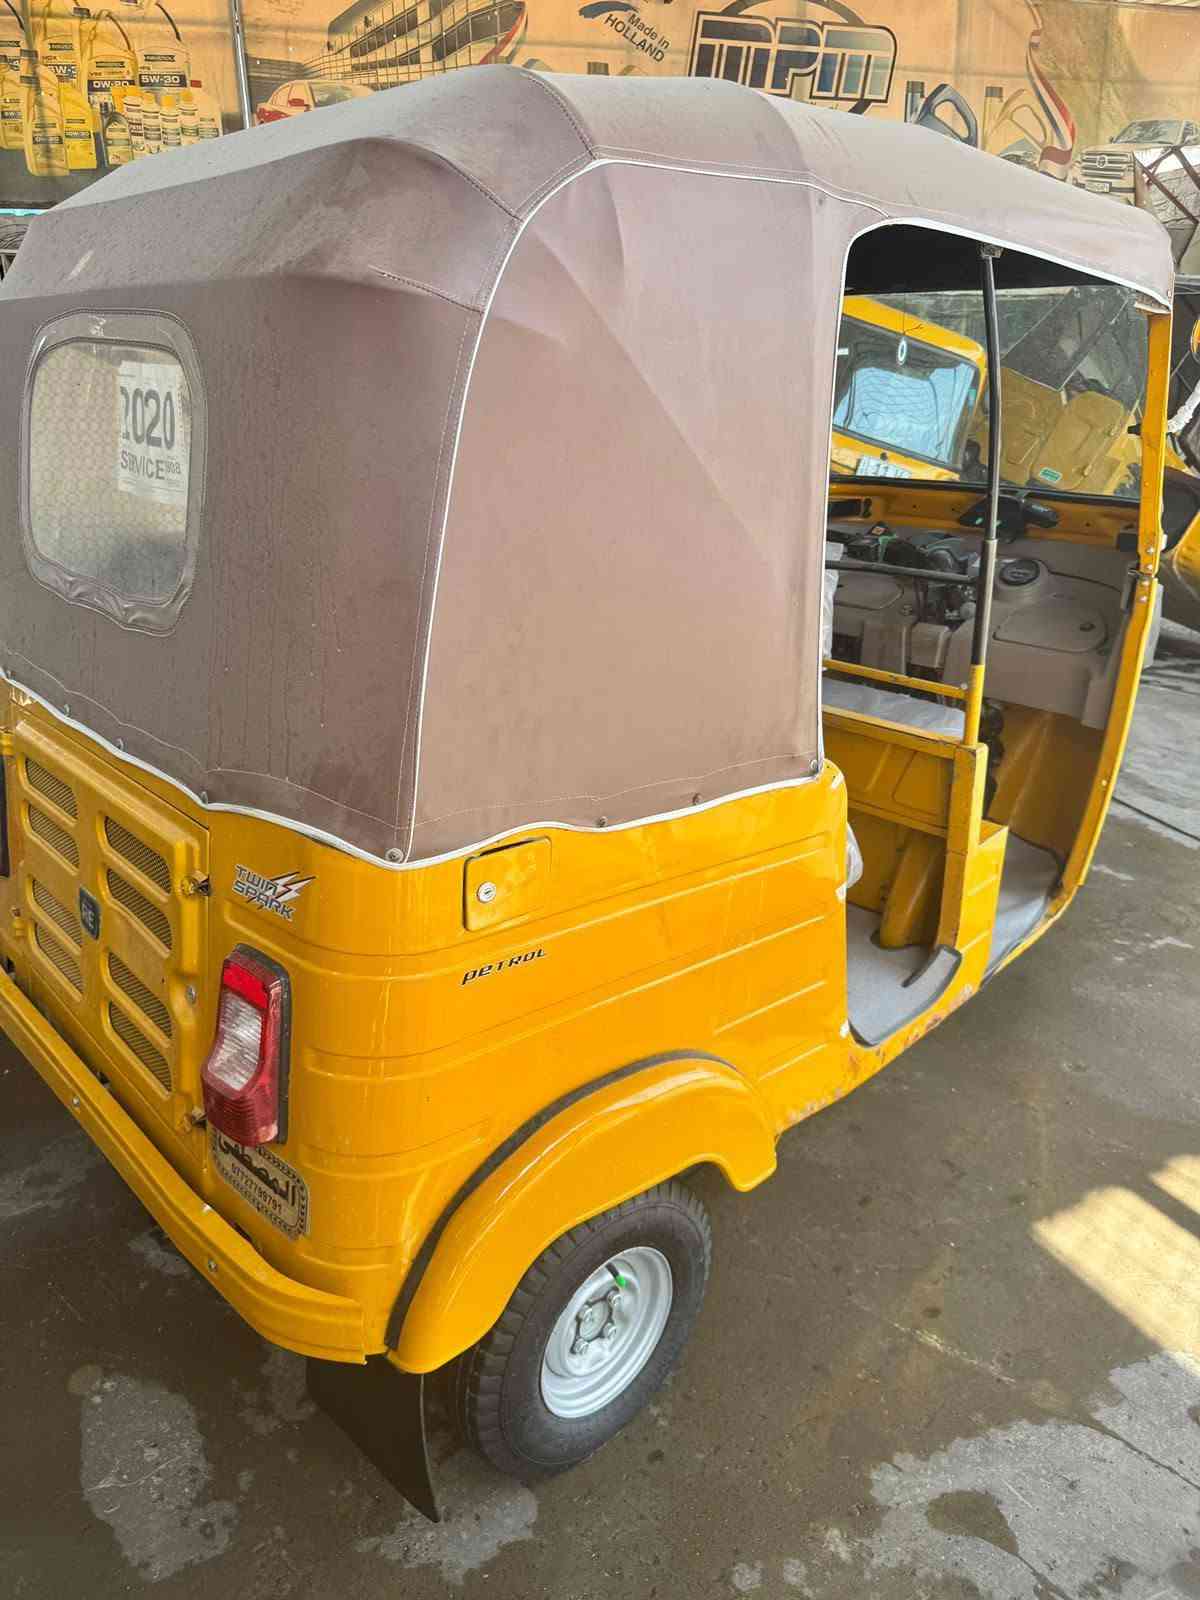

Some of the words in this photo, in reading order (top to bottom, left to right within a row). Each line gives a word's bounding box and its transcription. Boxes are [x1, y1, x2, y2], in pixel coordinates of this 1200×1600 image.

[603, 13, 665, 62] HOLLAND
[627, 13, 659, 41] Made
[141, 75, 180, 84] 5W-30
[231, 879, 296, 921] SPARK
